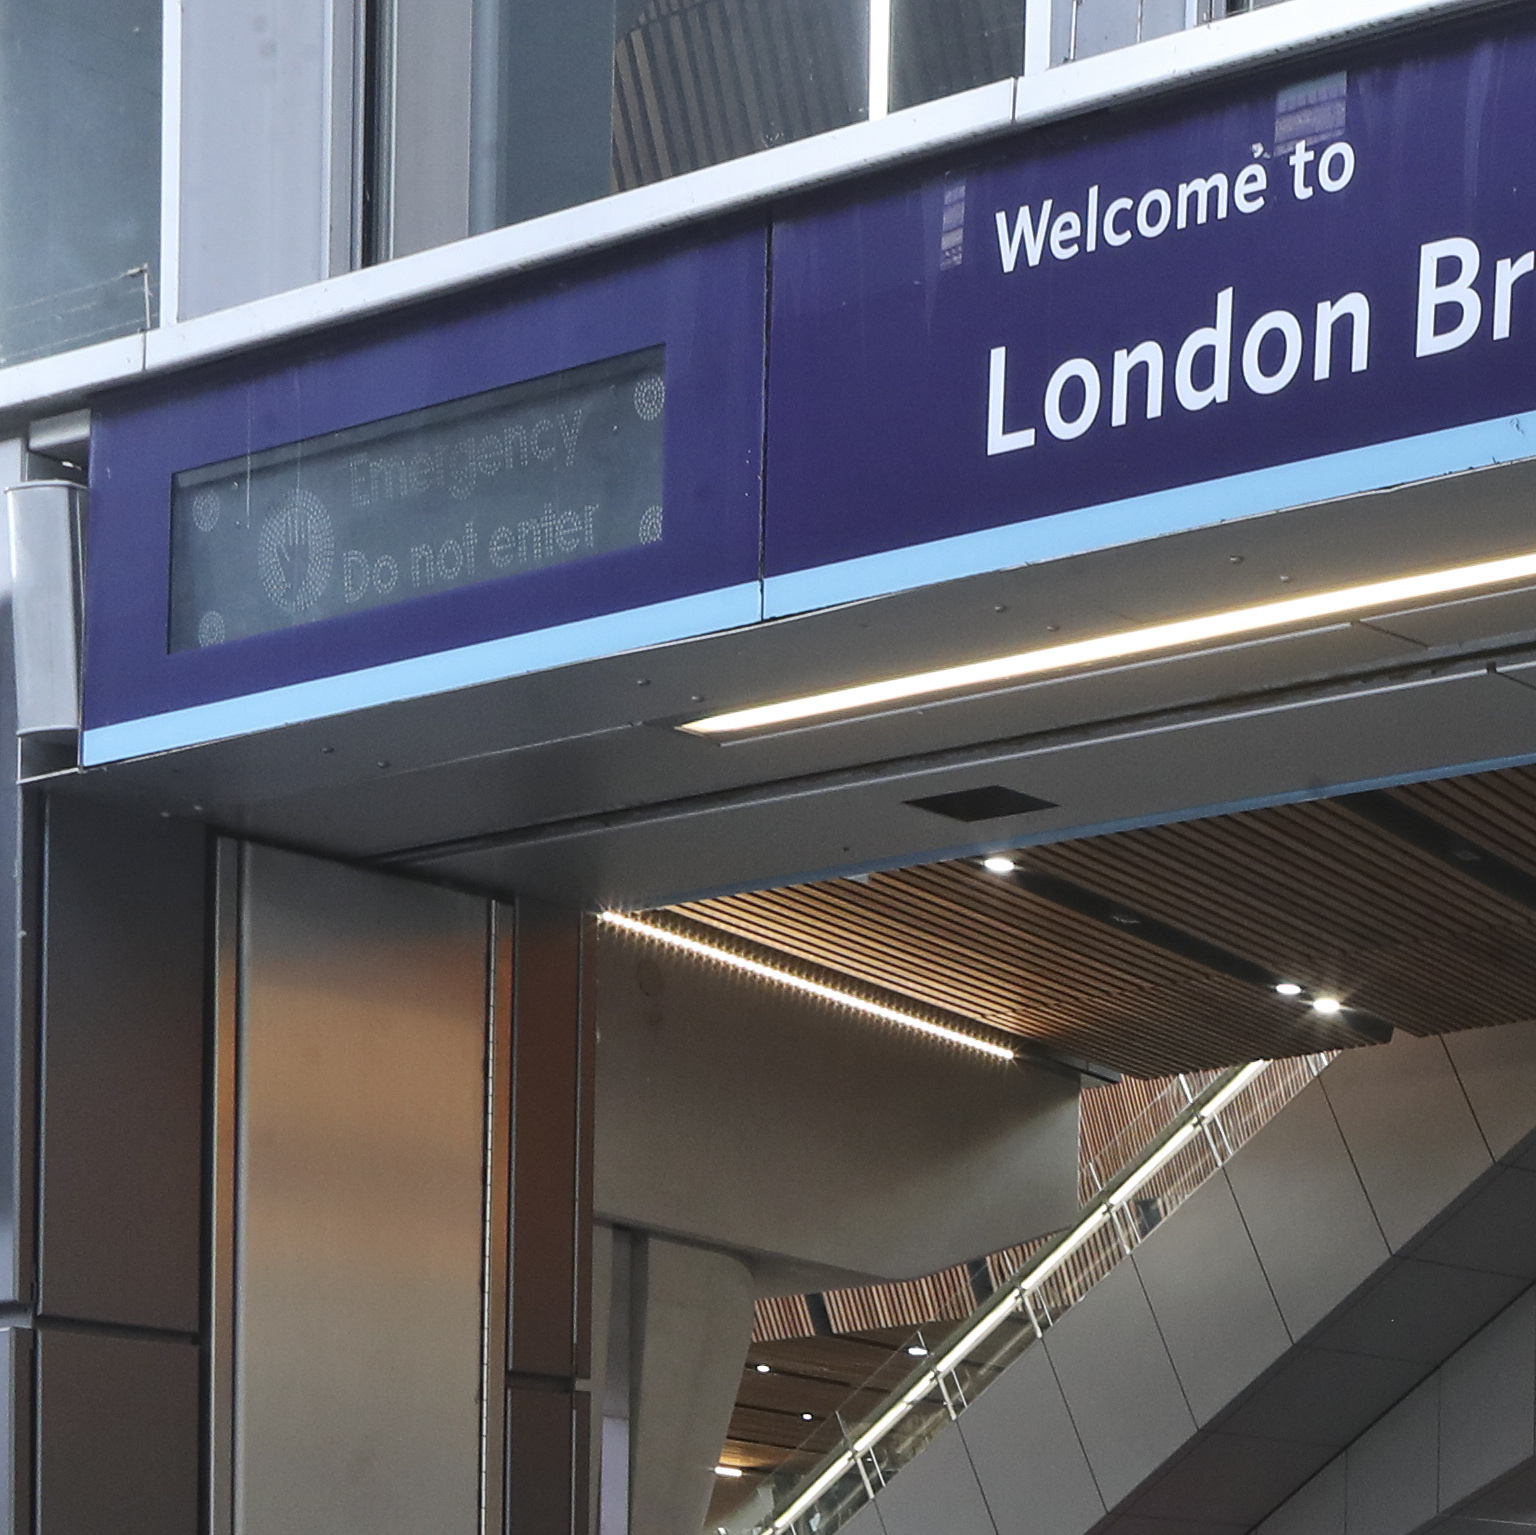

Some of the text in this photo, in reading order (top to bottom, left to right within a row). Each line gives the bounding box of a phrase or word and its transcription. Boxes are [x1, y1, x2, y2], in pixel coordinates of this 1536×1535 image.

[995, 140, 1355, 273] Welcome to
[987, 286, 1370, 456] London
[350, 409, 582, 506] Emergency
[344, 502, 599, 603] Do not enter
